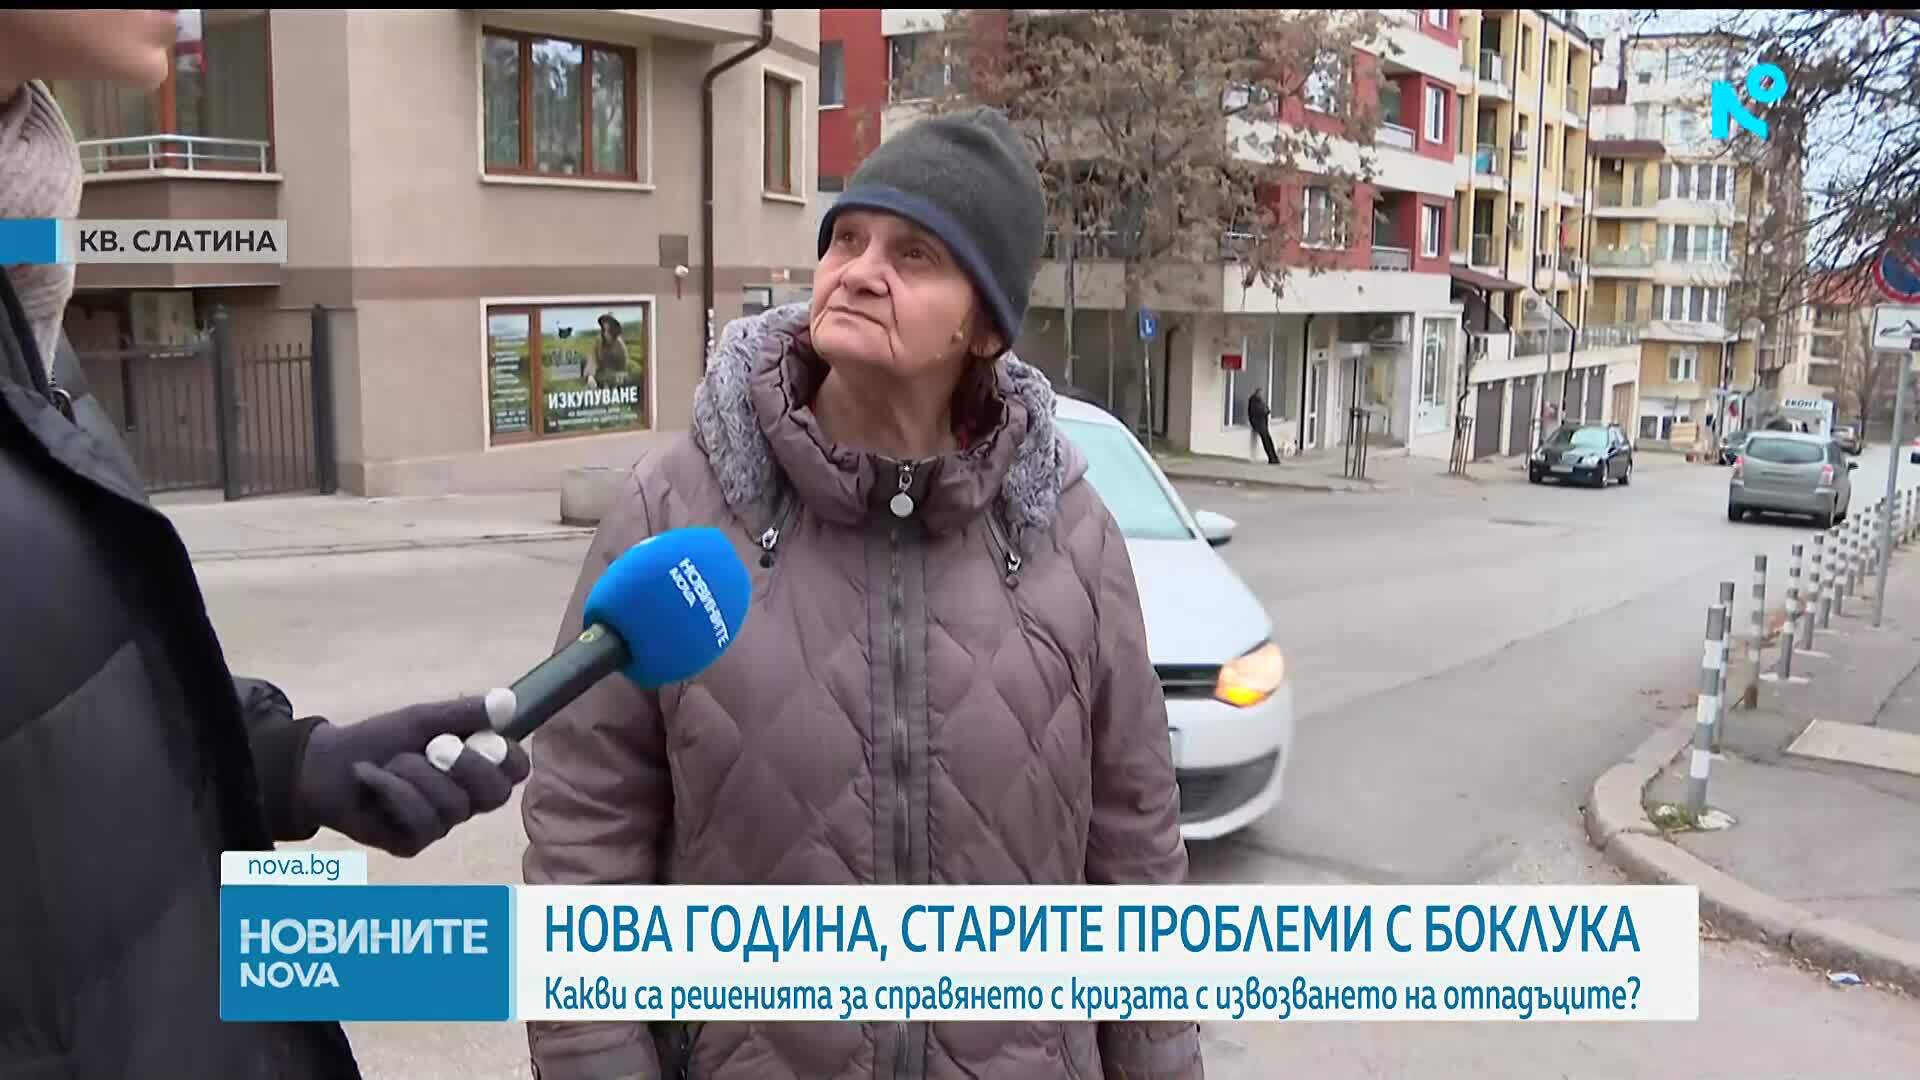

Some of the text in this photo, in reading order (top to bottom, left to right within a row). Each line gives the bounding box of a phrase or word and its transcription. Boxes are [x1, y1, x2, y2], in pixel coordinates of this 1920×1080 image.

[548, 386, 638, 409] ИЗКУПУВАНЕ
[669, 567, 697, 608] NOVA
[679, 557, 730, 648] НОВИНИТЕ
